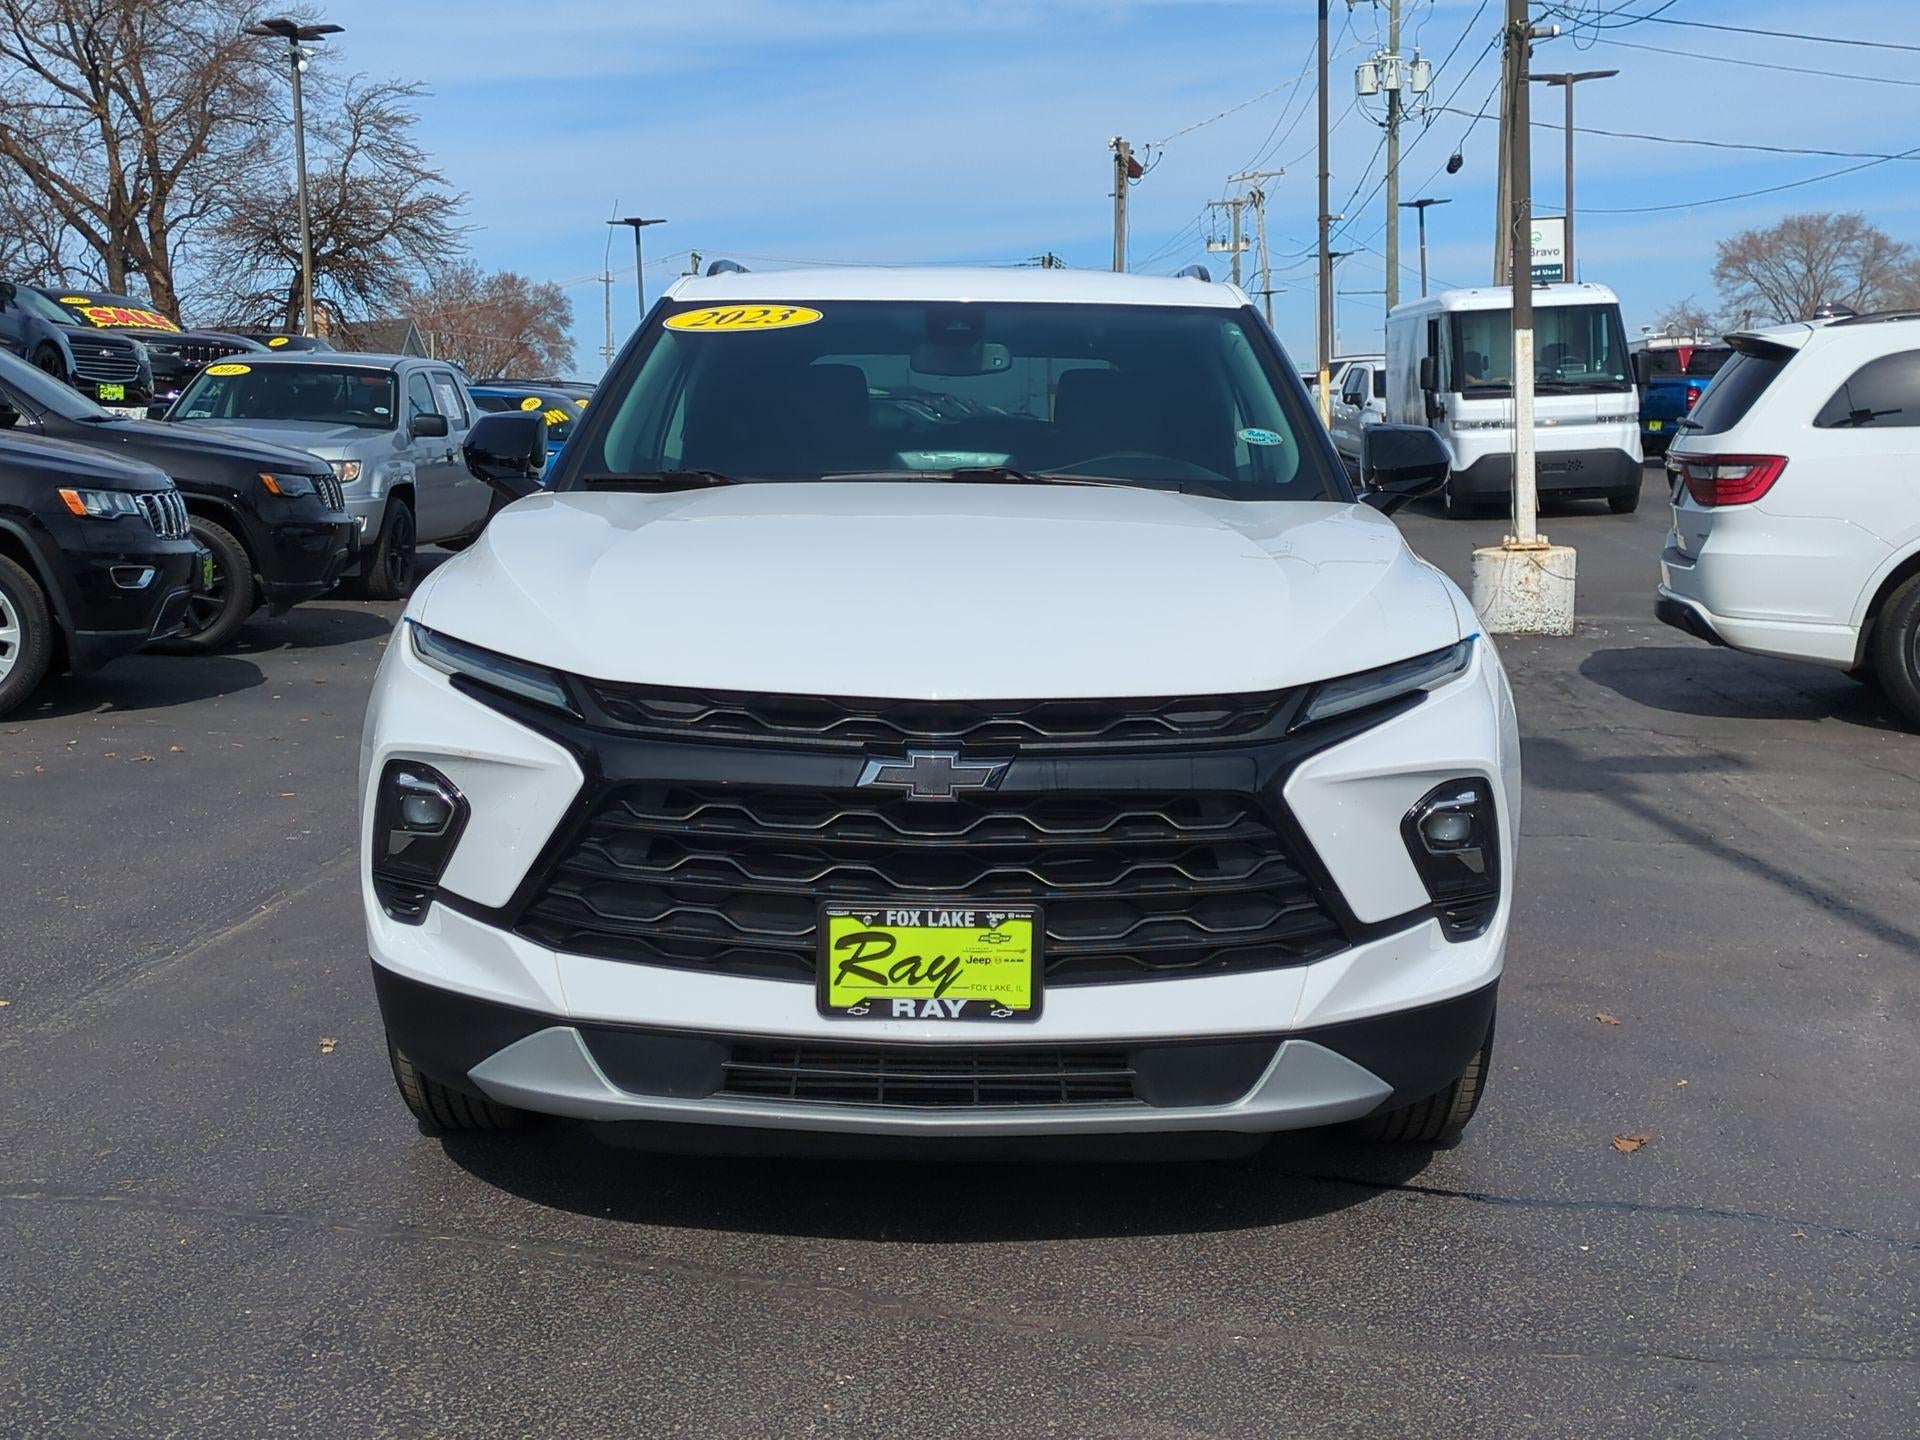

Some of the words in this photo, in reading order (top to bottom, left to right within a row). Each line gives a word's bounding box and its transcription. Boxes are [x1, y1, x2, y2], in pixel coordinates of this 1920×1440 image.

[88, 309, 176, 331] SALE
[686, 308, 798, 327] 2023
[886, 910, 921, 927] FOX
[928, 911, 975, 927] LAKE
[986, 912, 1005, 920] Jeep
[834, 931, 964, 998] Ray
[966, 955, 991, 965] Jeep
[970, 984, 988, 992] FOX
[892, 999, 968, 1018] RAY
